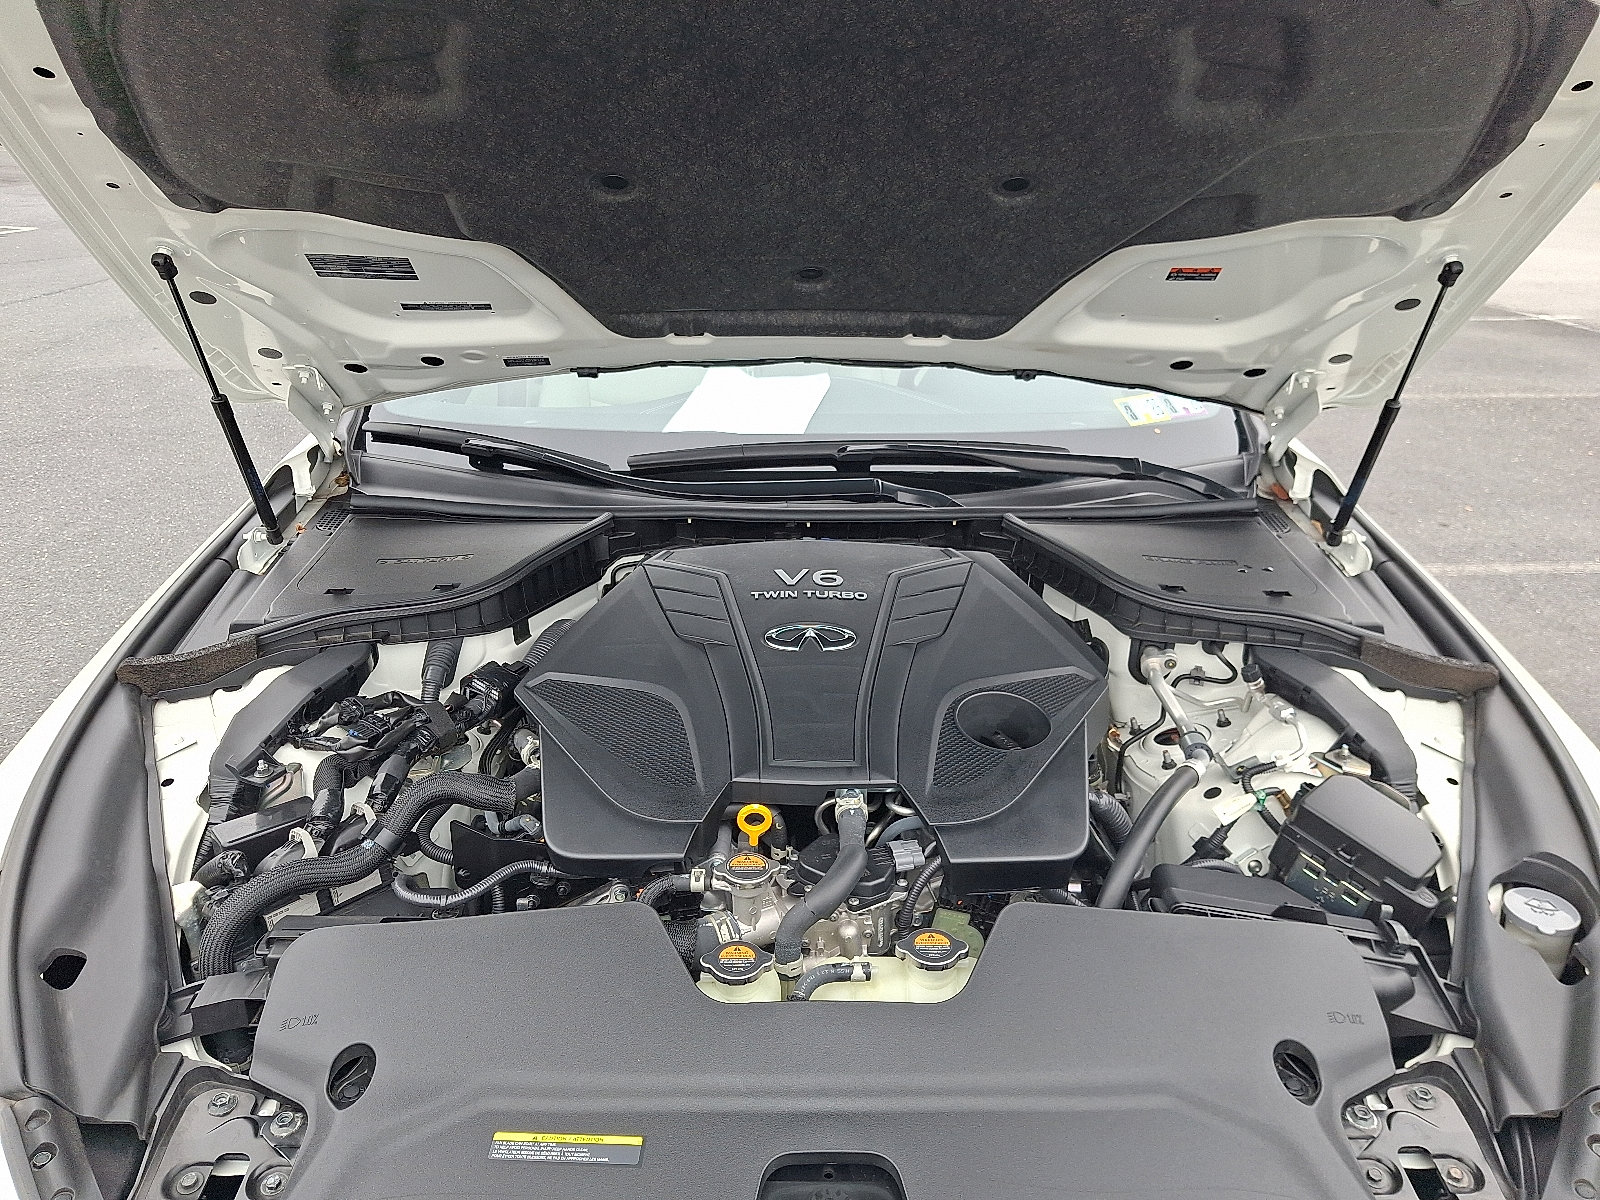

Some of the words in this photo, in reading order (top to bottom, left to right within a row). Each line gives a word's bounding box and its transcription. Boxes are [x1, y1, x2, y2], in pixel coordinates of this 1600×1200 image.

[773, 568, 844, 587] V6
[750, 590, 798, 599] TWIN
[802, 590, 868, 600] TURBO
